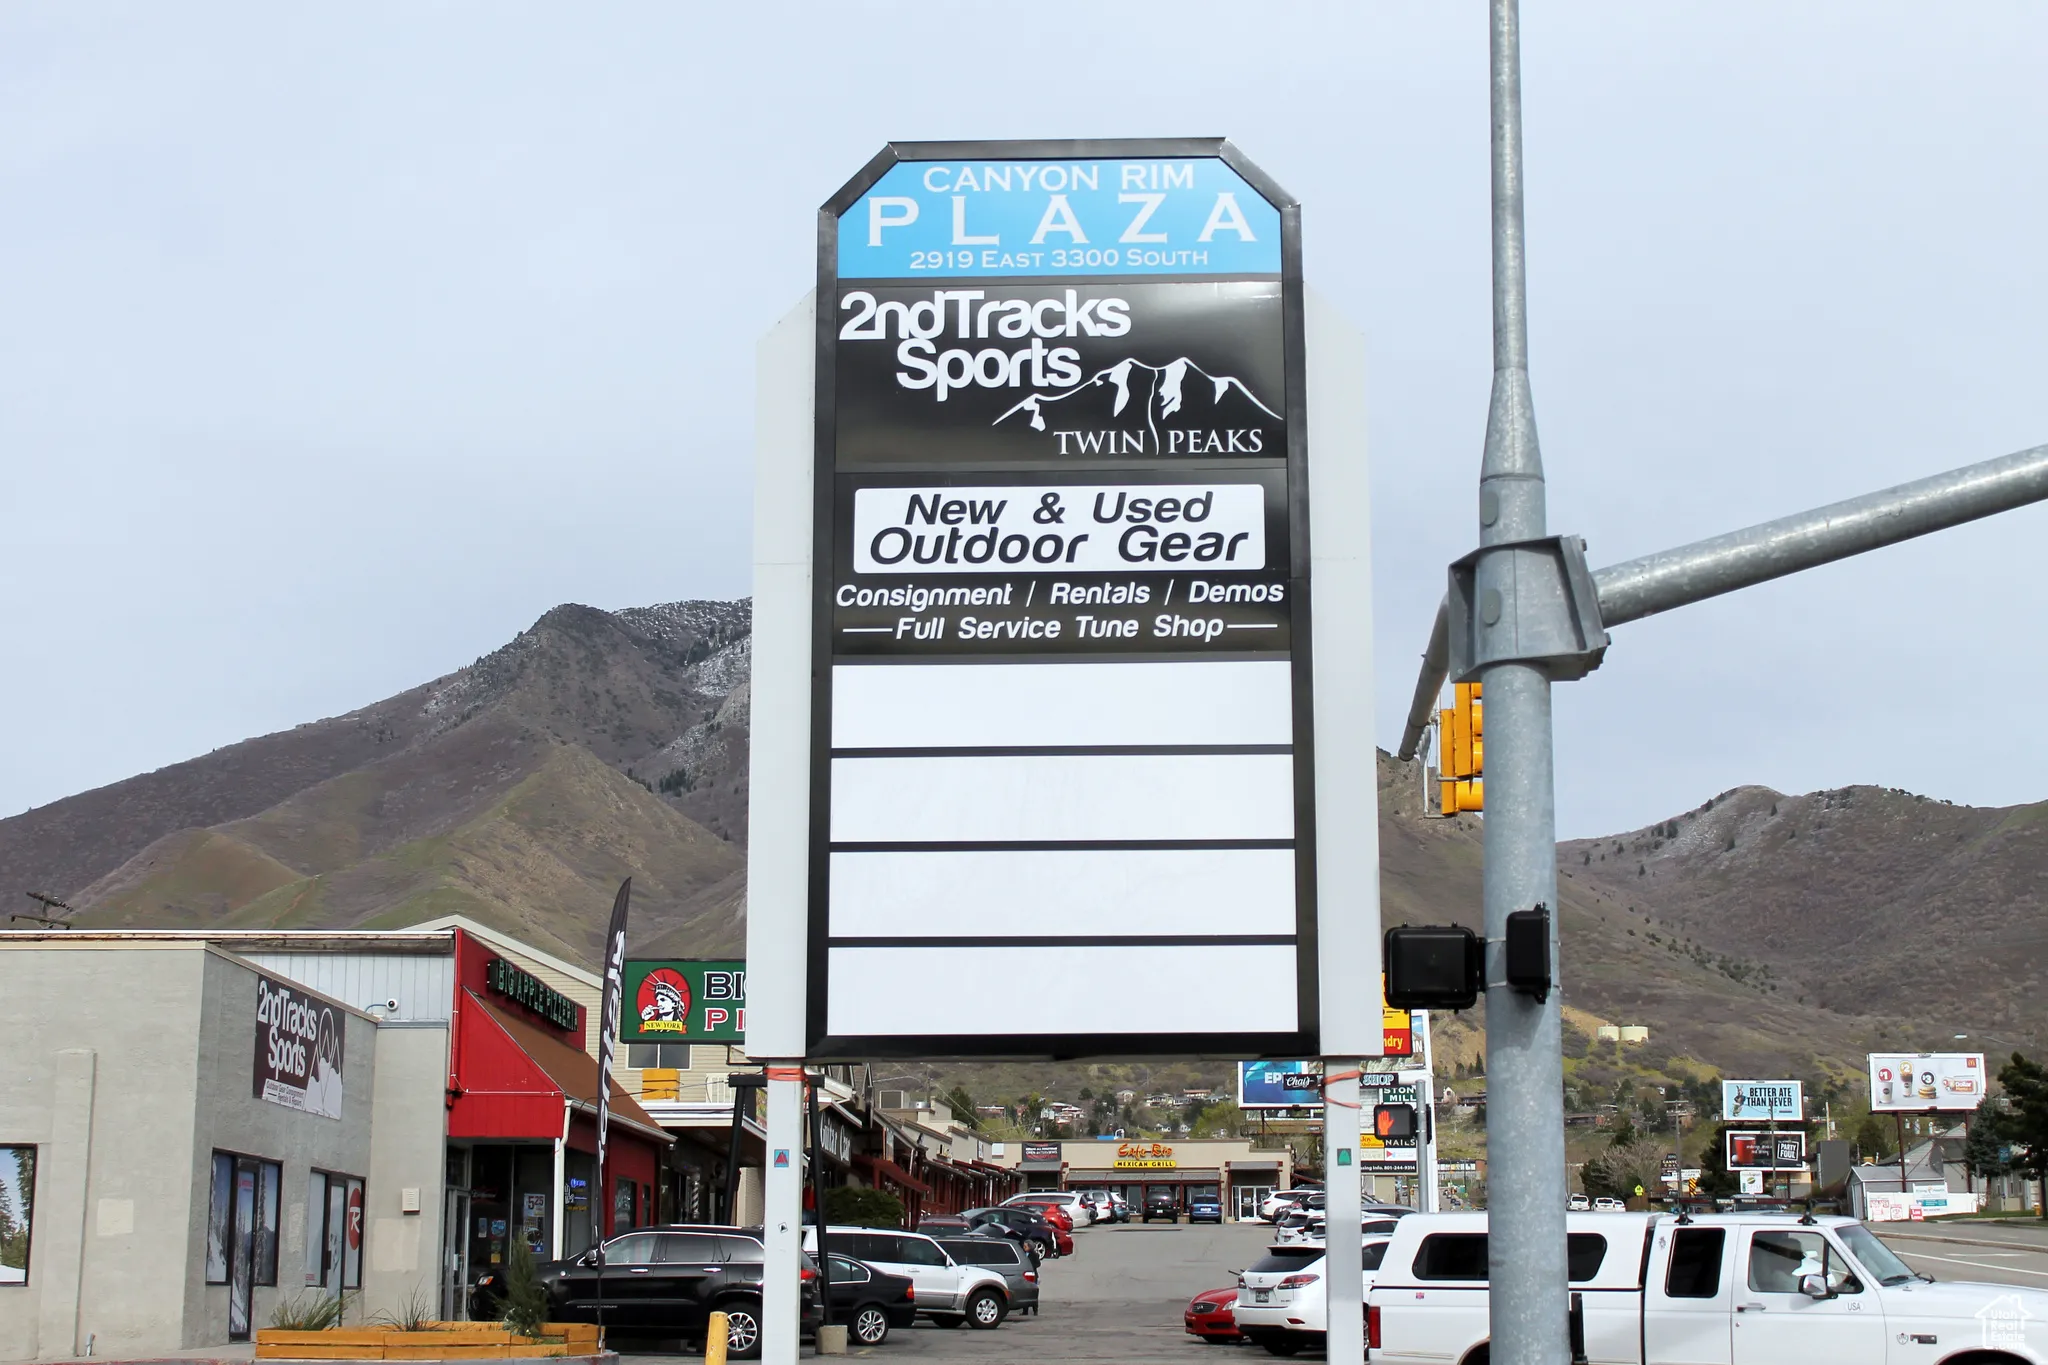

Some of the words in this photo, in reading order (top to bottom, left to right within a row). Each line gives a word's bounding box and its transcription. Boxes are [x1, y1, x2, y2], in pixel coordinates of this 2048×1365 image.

[923, 165, 1098, 193] CANYON
[1121, 164, 1195, 190] RIM
[867, 192, 1257, 247] PLAZA
[910, 251, 974, 269] 2919
[1051, 249, 1119, 267] 3300
[839, 289, 1132, 340] 2ndTracks
[896, 338, 1083, 402] Sports
[1053, 429, 1145, 455] TWIN
[1167, 429, 1263, 454] PEAKS
[905, 494, 1007, 525] New
[1033, 492, 1066, 524] &
[1092, 491, 1213, 523] Used
[870, 527, 1089, 565] Outdoor
[1117, 525, 1249, 562] Gear
[836, 583, 1013, 612] Consignment
[1050, 581, 1150, 606] Rentals
[1188, 580, 1284, 603] Demos
[896, 617, 945, 640] Full
[958, 616, 1061, 639] Service
[1076, 615, 1139, 637] Tune
[1153, 614, 1224, 642] Shop
[498, 960, 515, 996] BIG
[516, 971, 544, 1014] APPLE
[703, 971, 746, 1000] BI
[258, 980, 317, 1041] 2ndTracks
[663, 1022, 681, 1030] YORK
[268, 1025, 306, 1080] Sports
[1363, 1074, 1394, 1085] SHOP
[1749, 1087, 1777, 1096] BETTER
[1779, 1087, 1791, 1096] ATE
[1747, 1097, 1766, 1107] THAN
[1768, 1097, 1792, 1107] NEVER
[1780, 1150, 1795, 1158] FOUL
[1781, 1143, 1796, 1152] PARTY
[1847, 1303, 1861, 1311] USA
